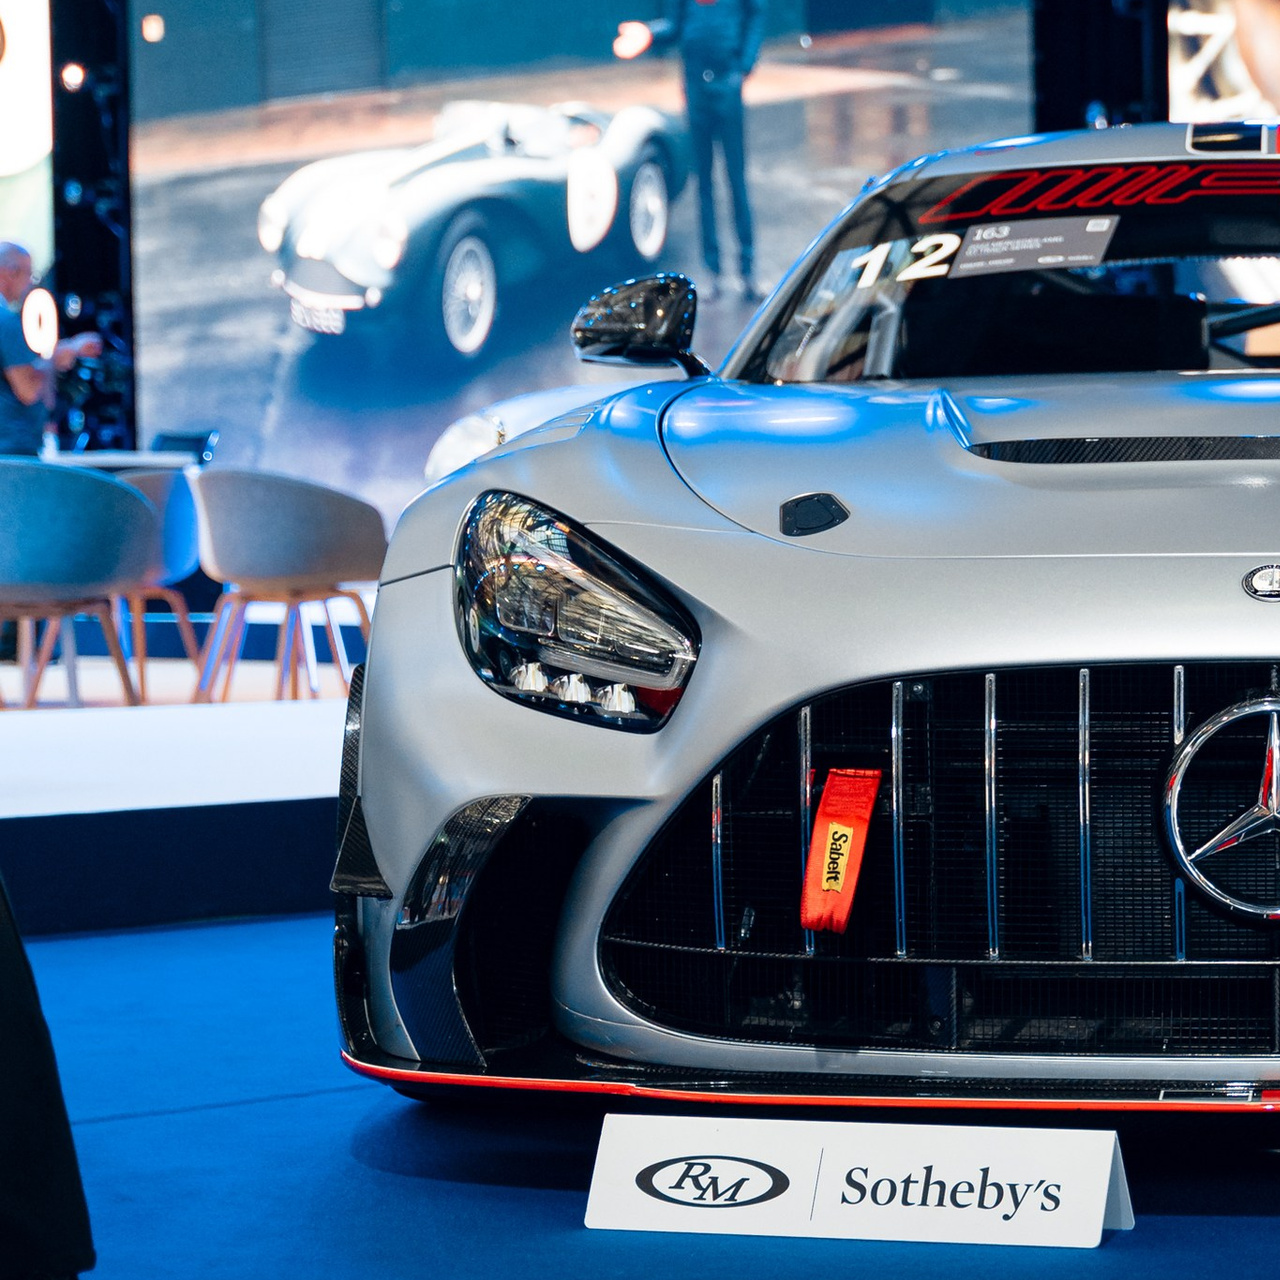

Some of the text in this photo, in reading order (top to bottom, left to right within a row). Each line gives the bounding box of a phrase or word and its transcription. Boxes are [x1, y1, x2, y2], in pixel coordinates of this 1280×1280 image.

[973, 226, 1011, 240] 163
[851, 233, 962, 289] 12
[825, 830, 849, 883] Sabelt
[667, 1161, 1062, 1221] RM Sotheby's
